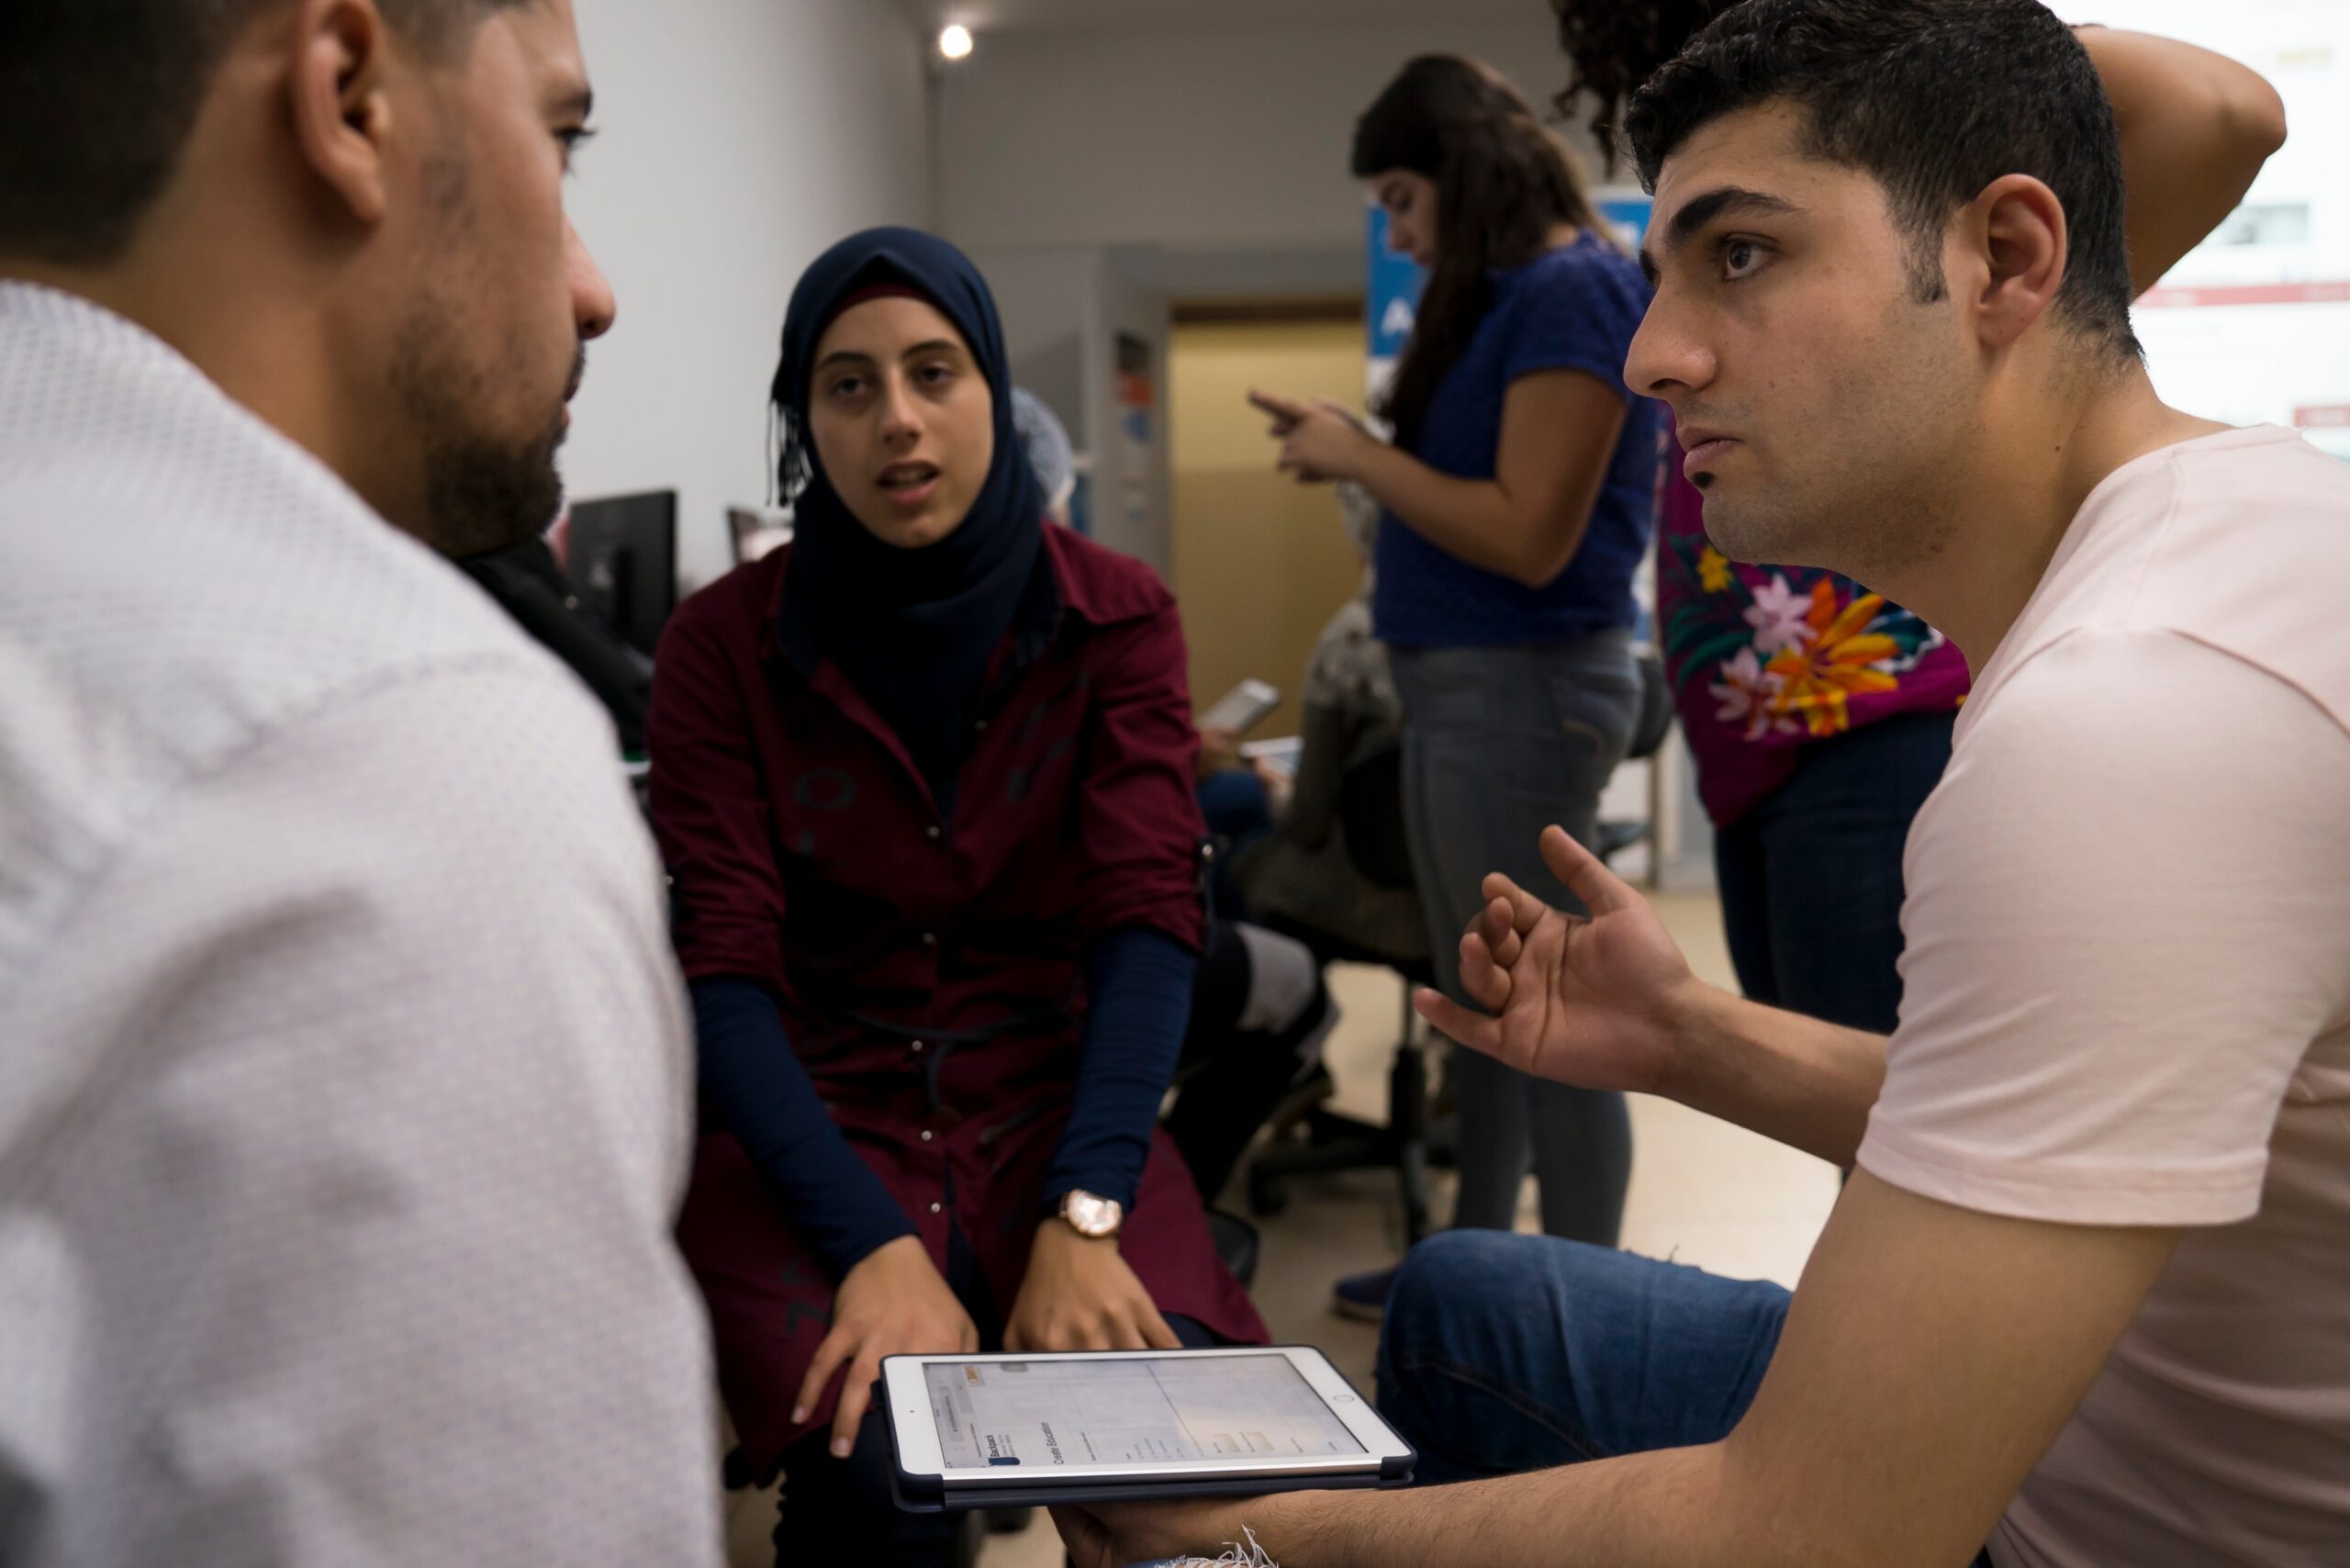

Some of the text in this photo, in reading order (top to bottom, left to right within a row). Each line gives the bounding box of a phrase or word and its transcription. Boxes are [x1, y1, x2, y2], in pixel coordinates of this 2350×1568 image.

[984, 1434, 1000, 1458] Backpack
[1040, 1422, 1065, 1465] Create Education
